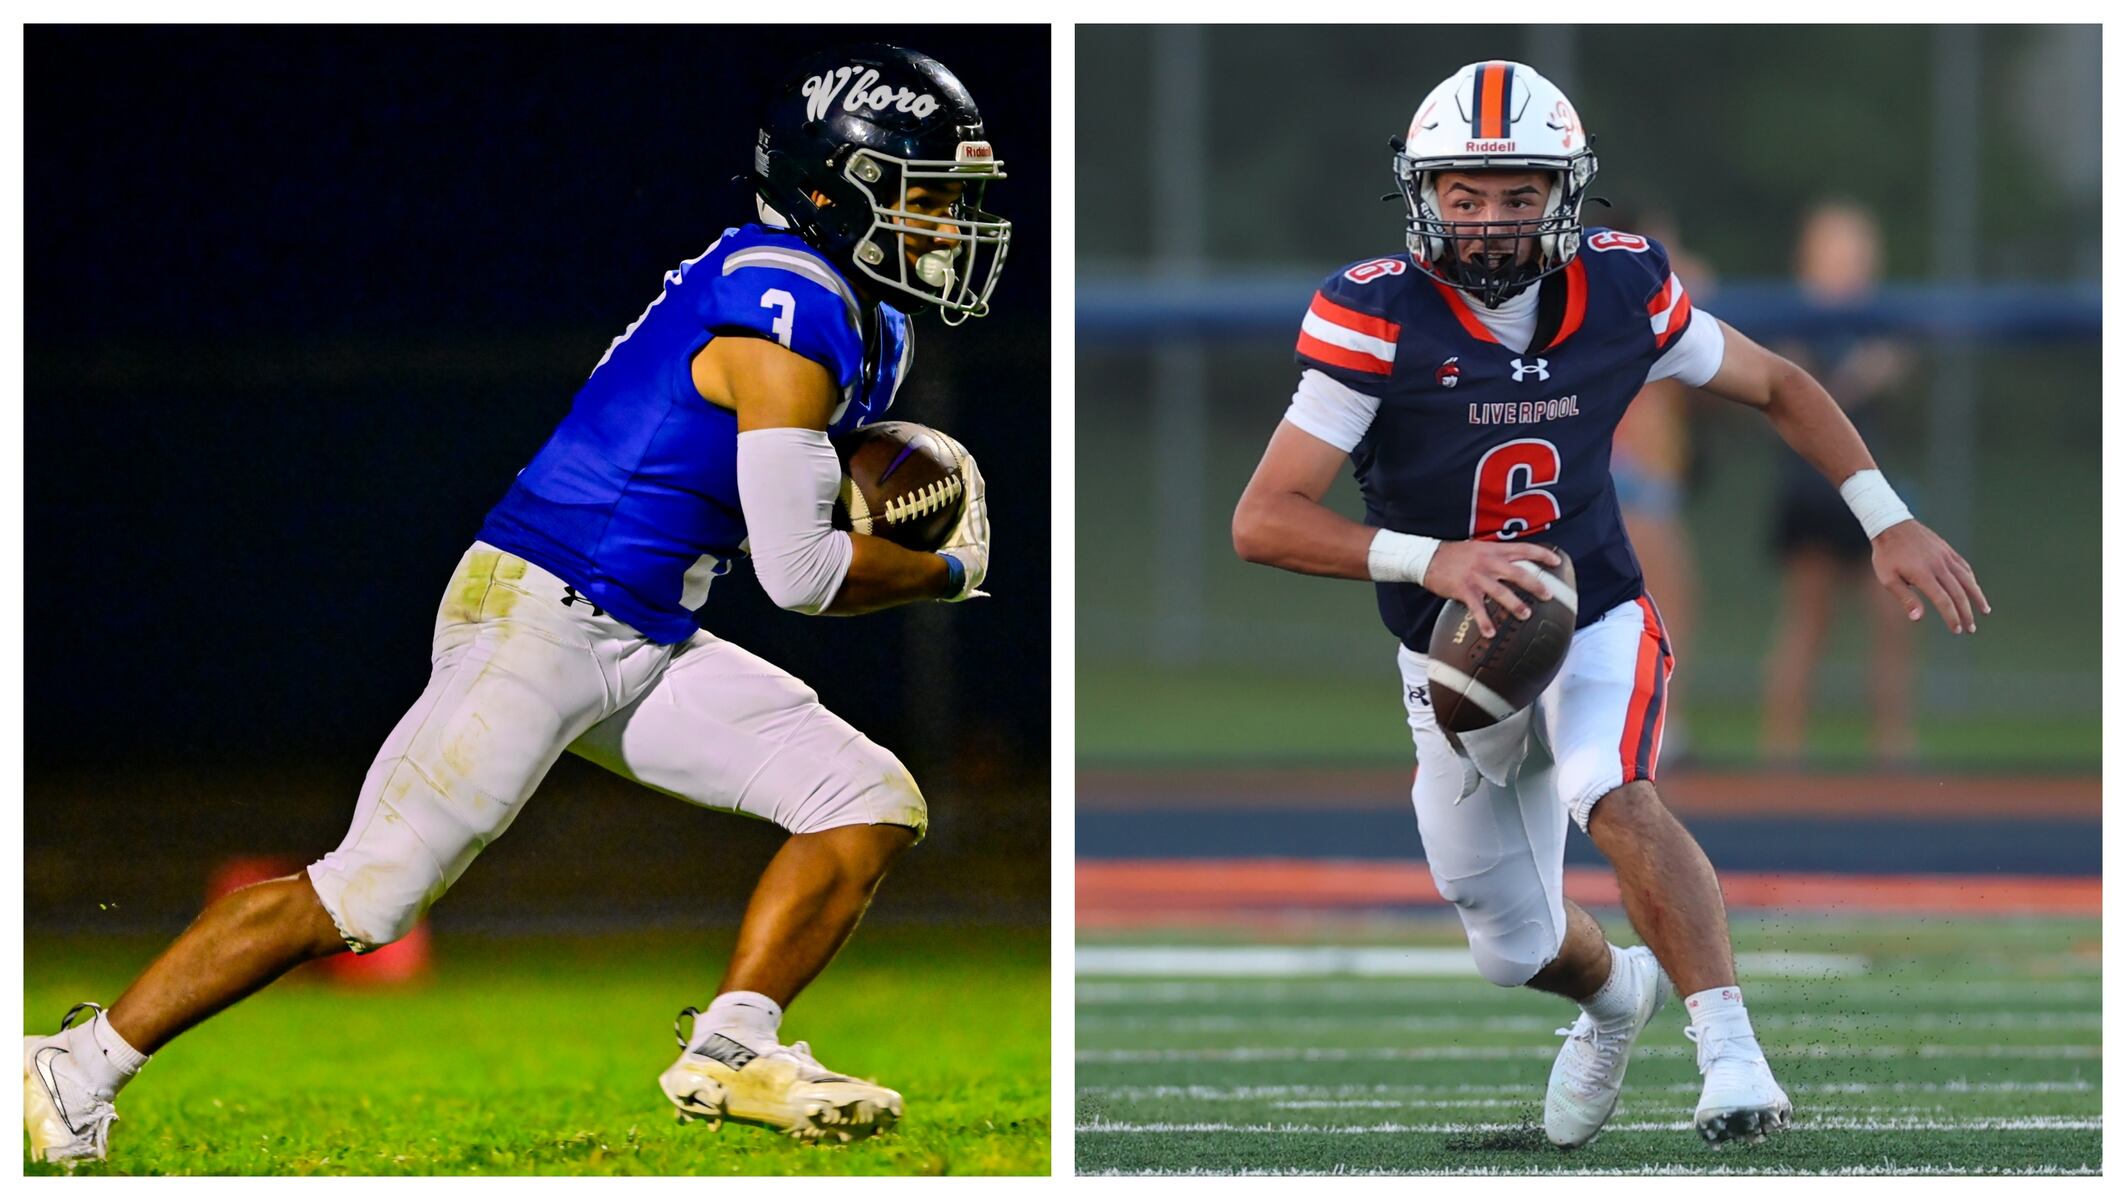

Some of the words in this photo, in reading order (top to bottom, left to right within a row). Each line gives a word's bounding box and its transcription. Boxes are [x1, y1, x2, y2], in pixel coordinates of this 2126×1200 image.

[802, 66, 939, 122] W'boro
[1466, 142, 1516, 152] Riddell
[1587, 231, 1650, 253] 6
[1344, 258, 1407, 284] 6
[760, 288, 796, 349] 3
[1468, 395, 1581, 425] LIVERPOOL
[1469, 438, 1562, 541] 6
